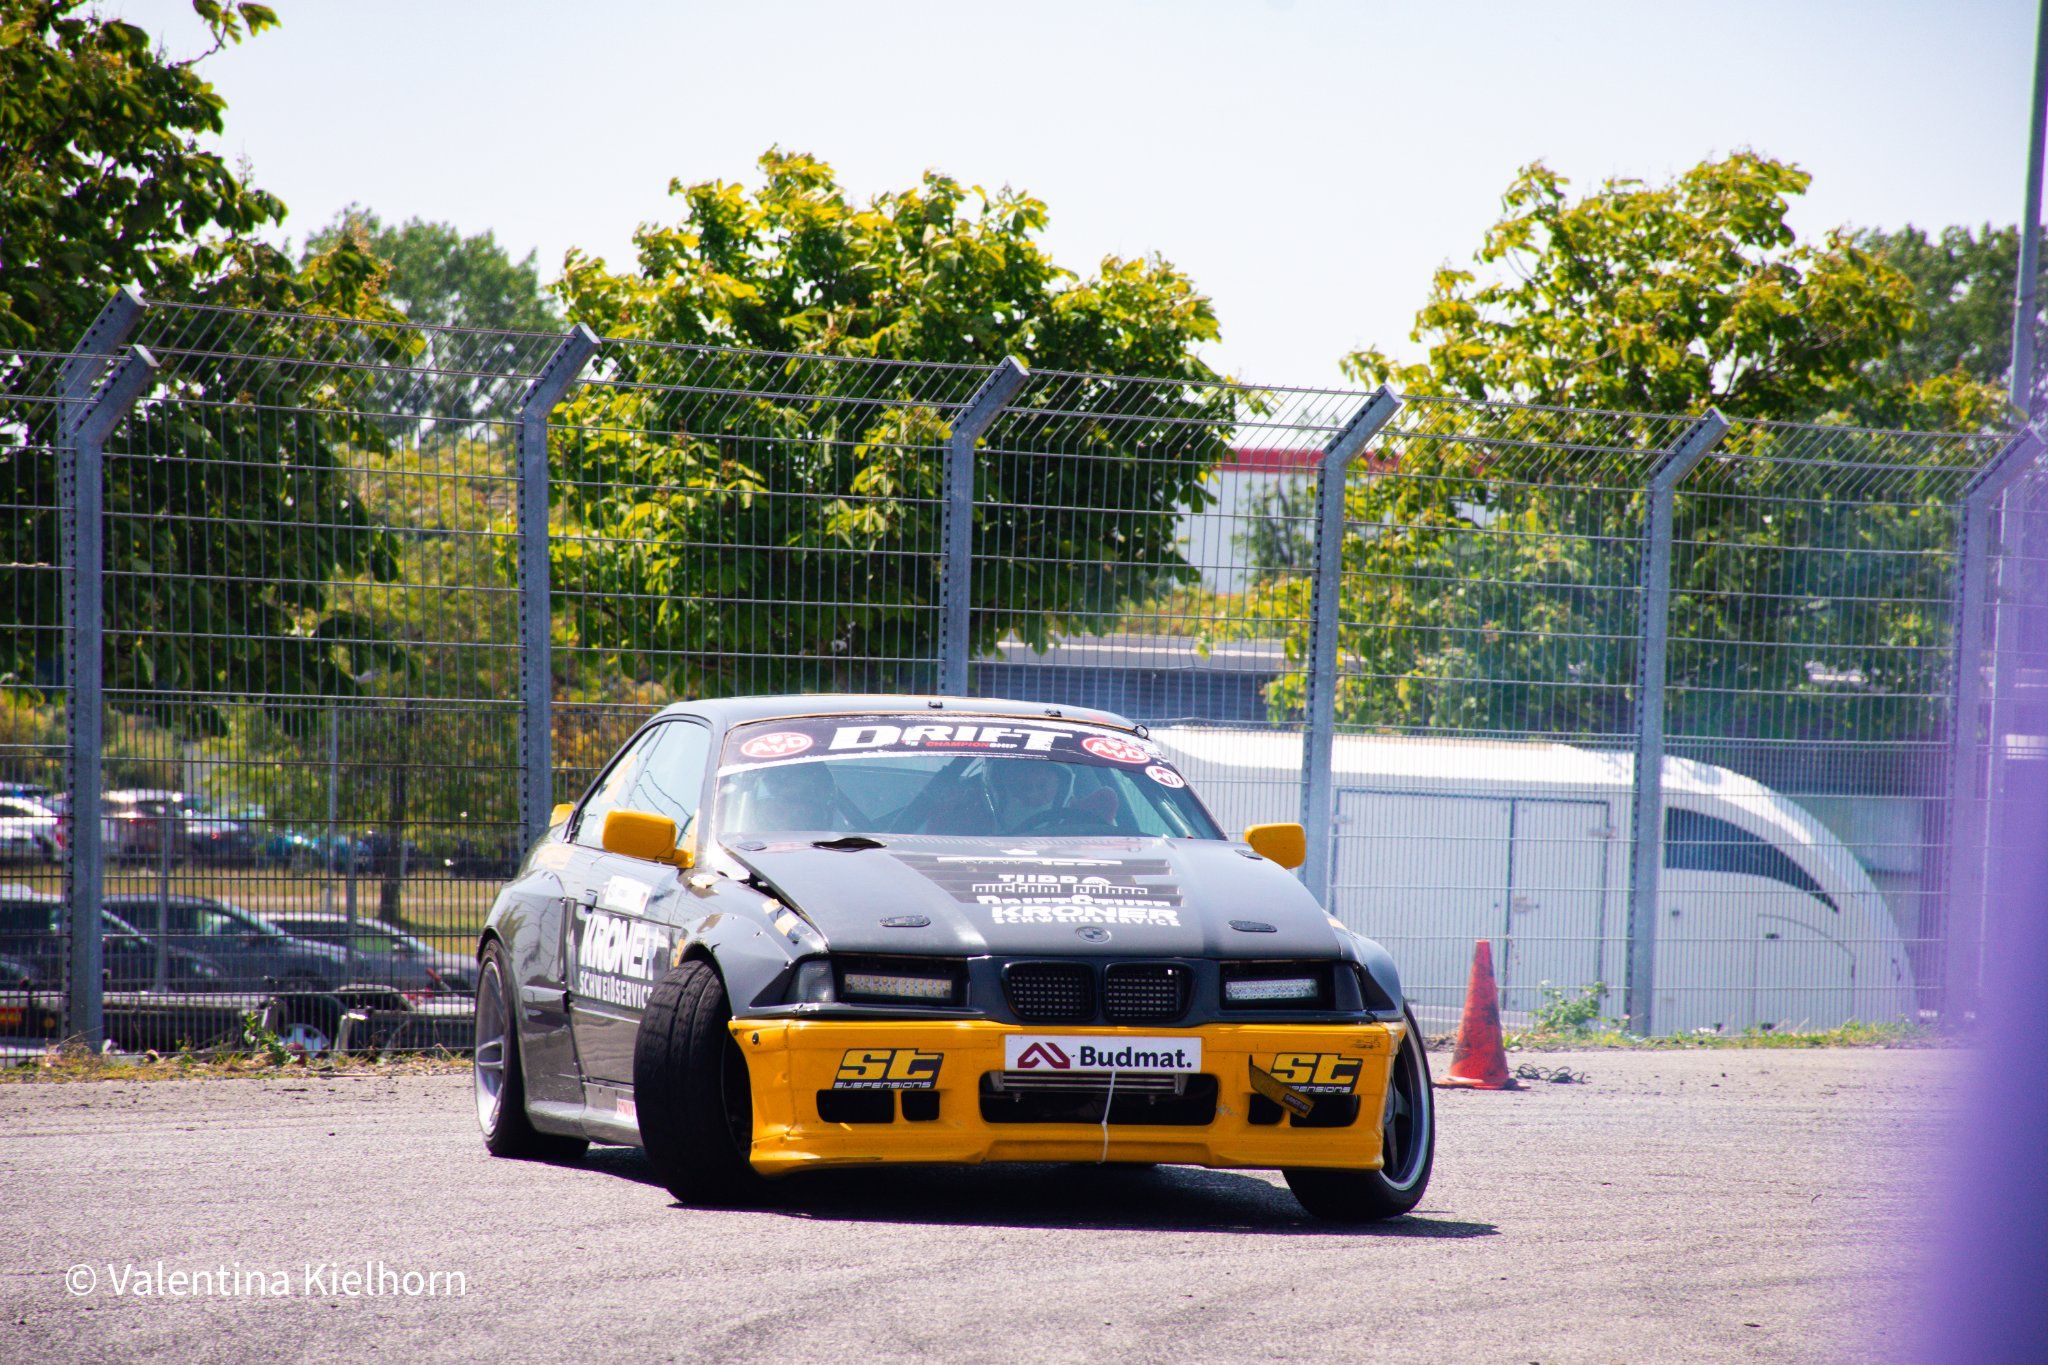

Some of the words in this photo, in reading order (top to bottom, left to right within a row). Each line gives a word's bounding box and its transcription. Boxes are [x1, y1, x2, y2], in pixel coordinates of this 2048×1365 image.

[828, 725, 1073, 751] DRIFT
[991, 906, 1178, 920] KRONER
[1079, 1045, 1192, 1068] Budmat.
